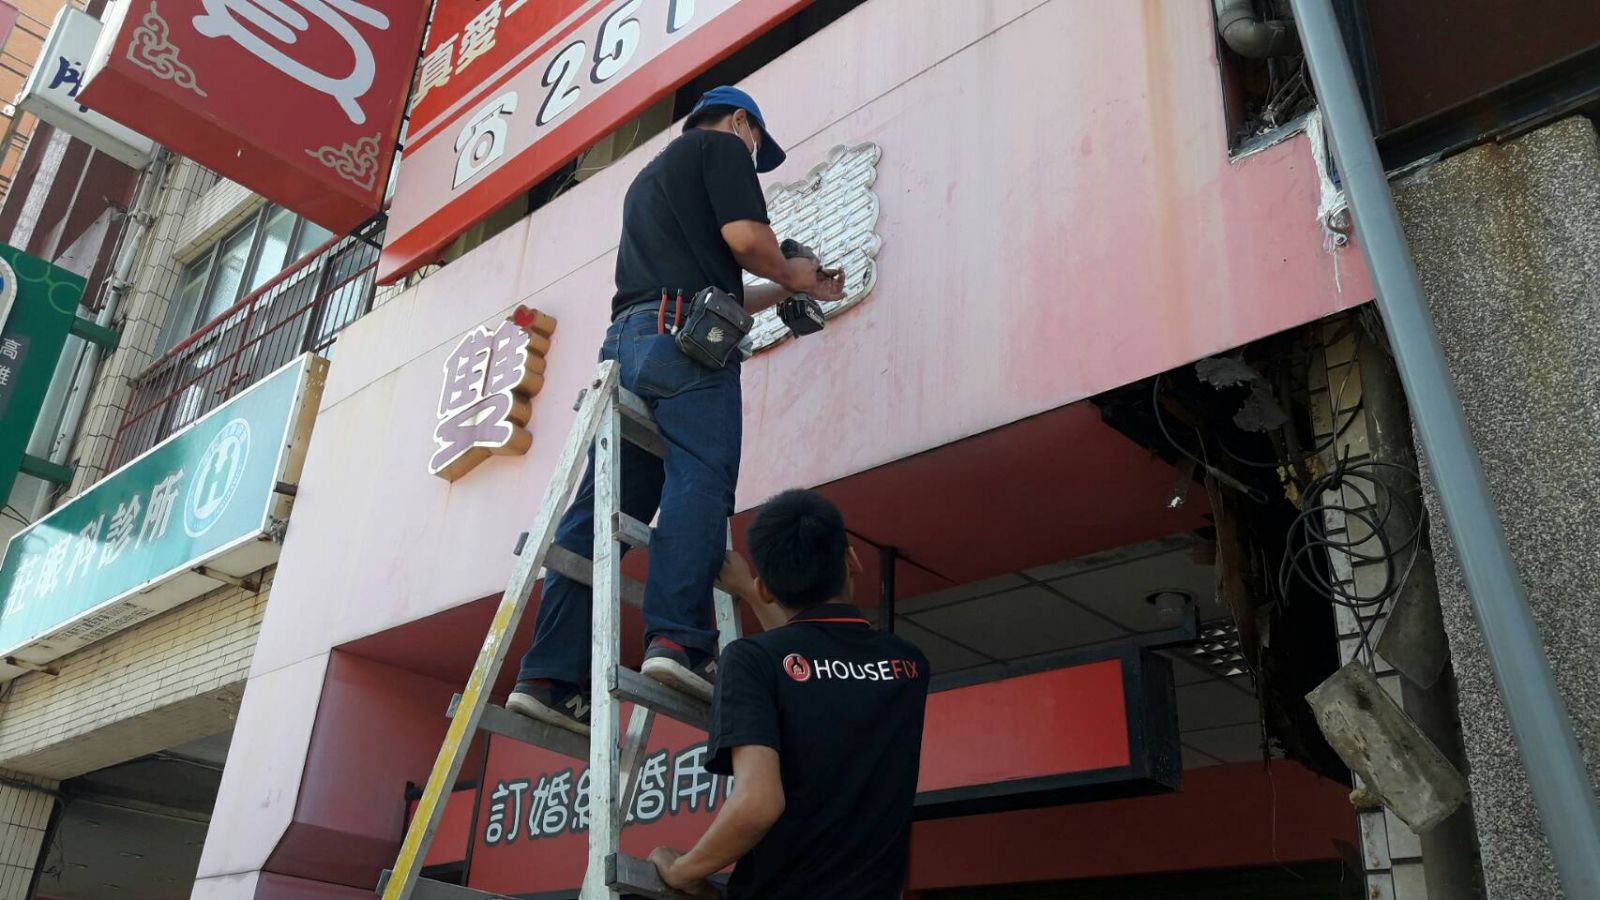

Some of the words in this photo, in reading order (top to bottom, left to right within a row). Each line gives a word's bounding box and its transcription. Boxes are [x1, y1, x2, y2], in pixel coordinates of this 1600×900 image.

[409, 0, 528, 109] 真愛
[428, 308, 536, 478] 雙
[813, 659, 919, 681] HOUSEFIX
[486, 746, 735, 843] 訂婚婚用
